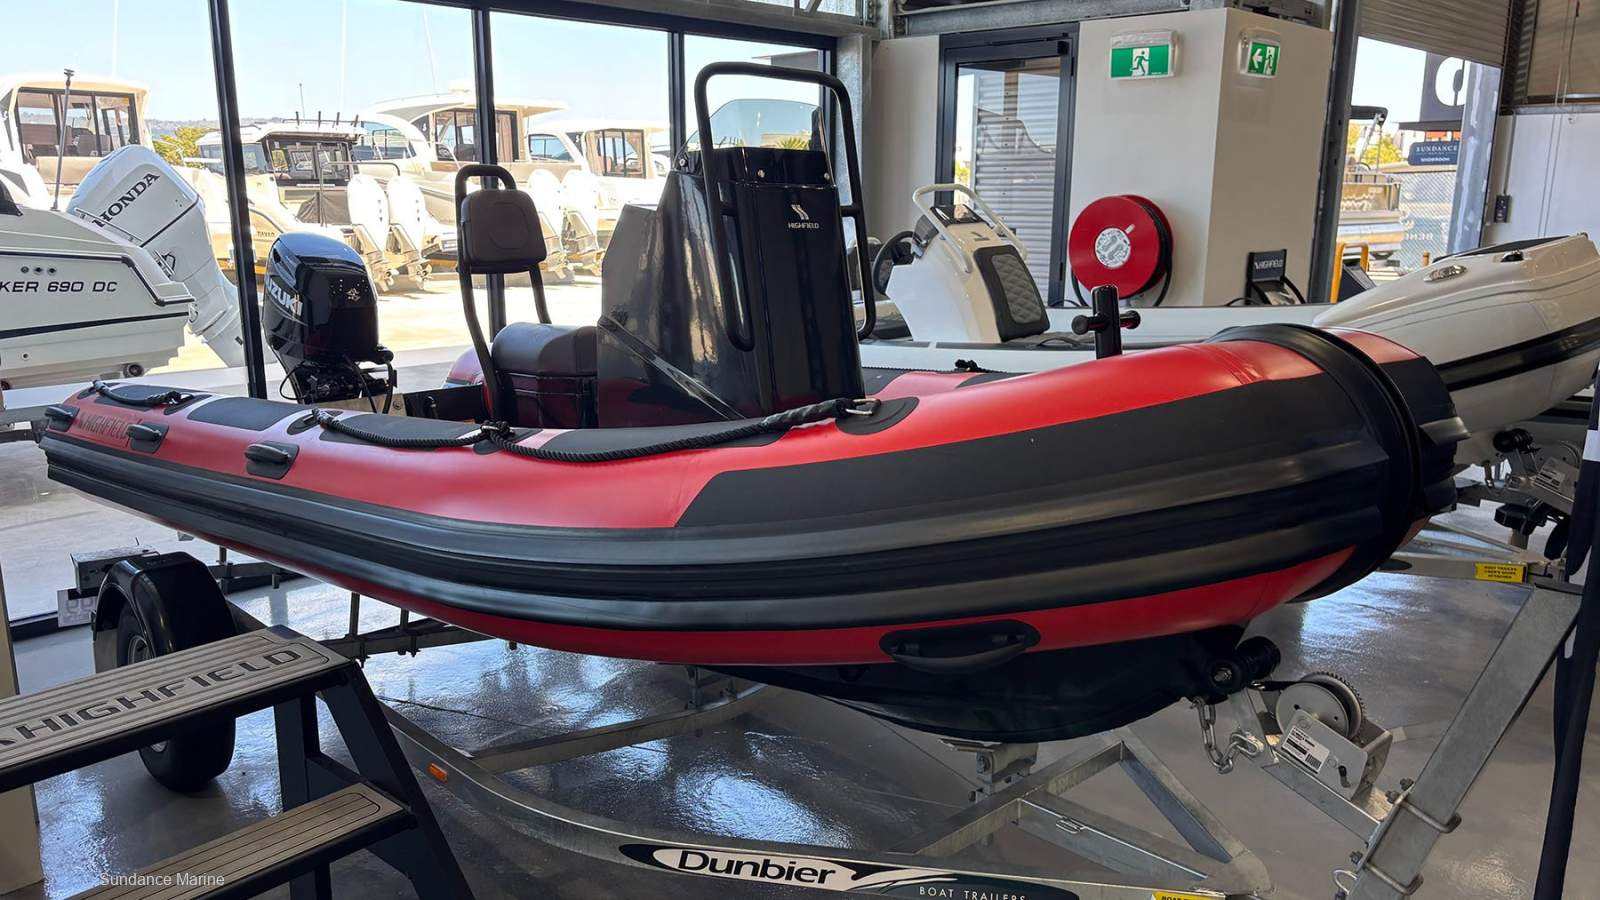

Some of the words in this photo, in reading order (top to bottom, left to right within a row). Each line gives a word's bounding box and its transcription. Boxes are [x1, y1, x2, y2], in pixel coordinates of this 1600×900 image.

[92, 173, 160, 228] HONDA
[47, 281, 84, 293] 690
[92, 281, 118, 293] DC
[264, 274, 303, 316] UZUKI
[15, 650, 301, 740] HIGHFIELD
[678, 850, 836, 884] Dunbier
[919, 886, 954, 898] BOAT
